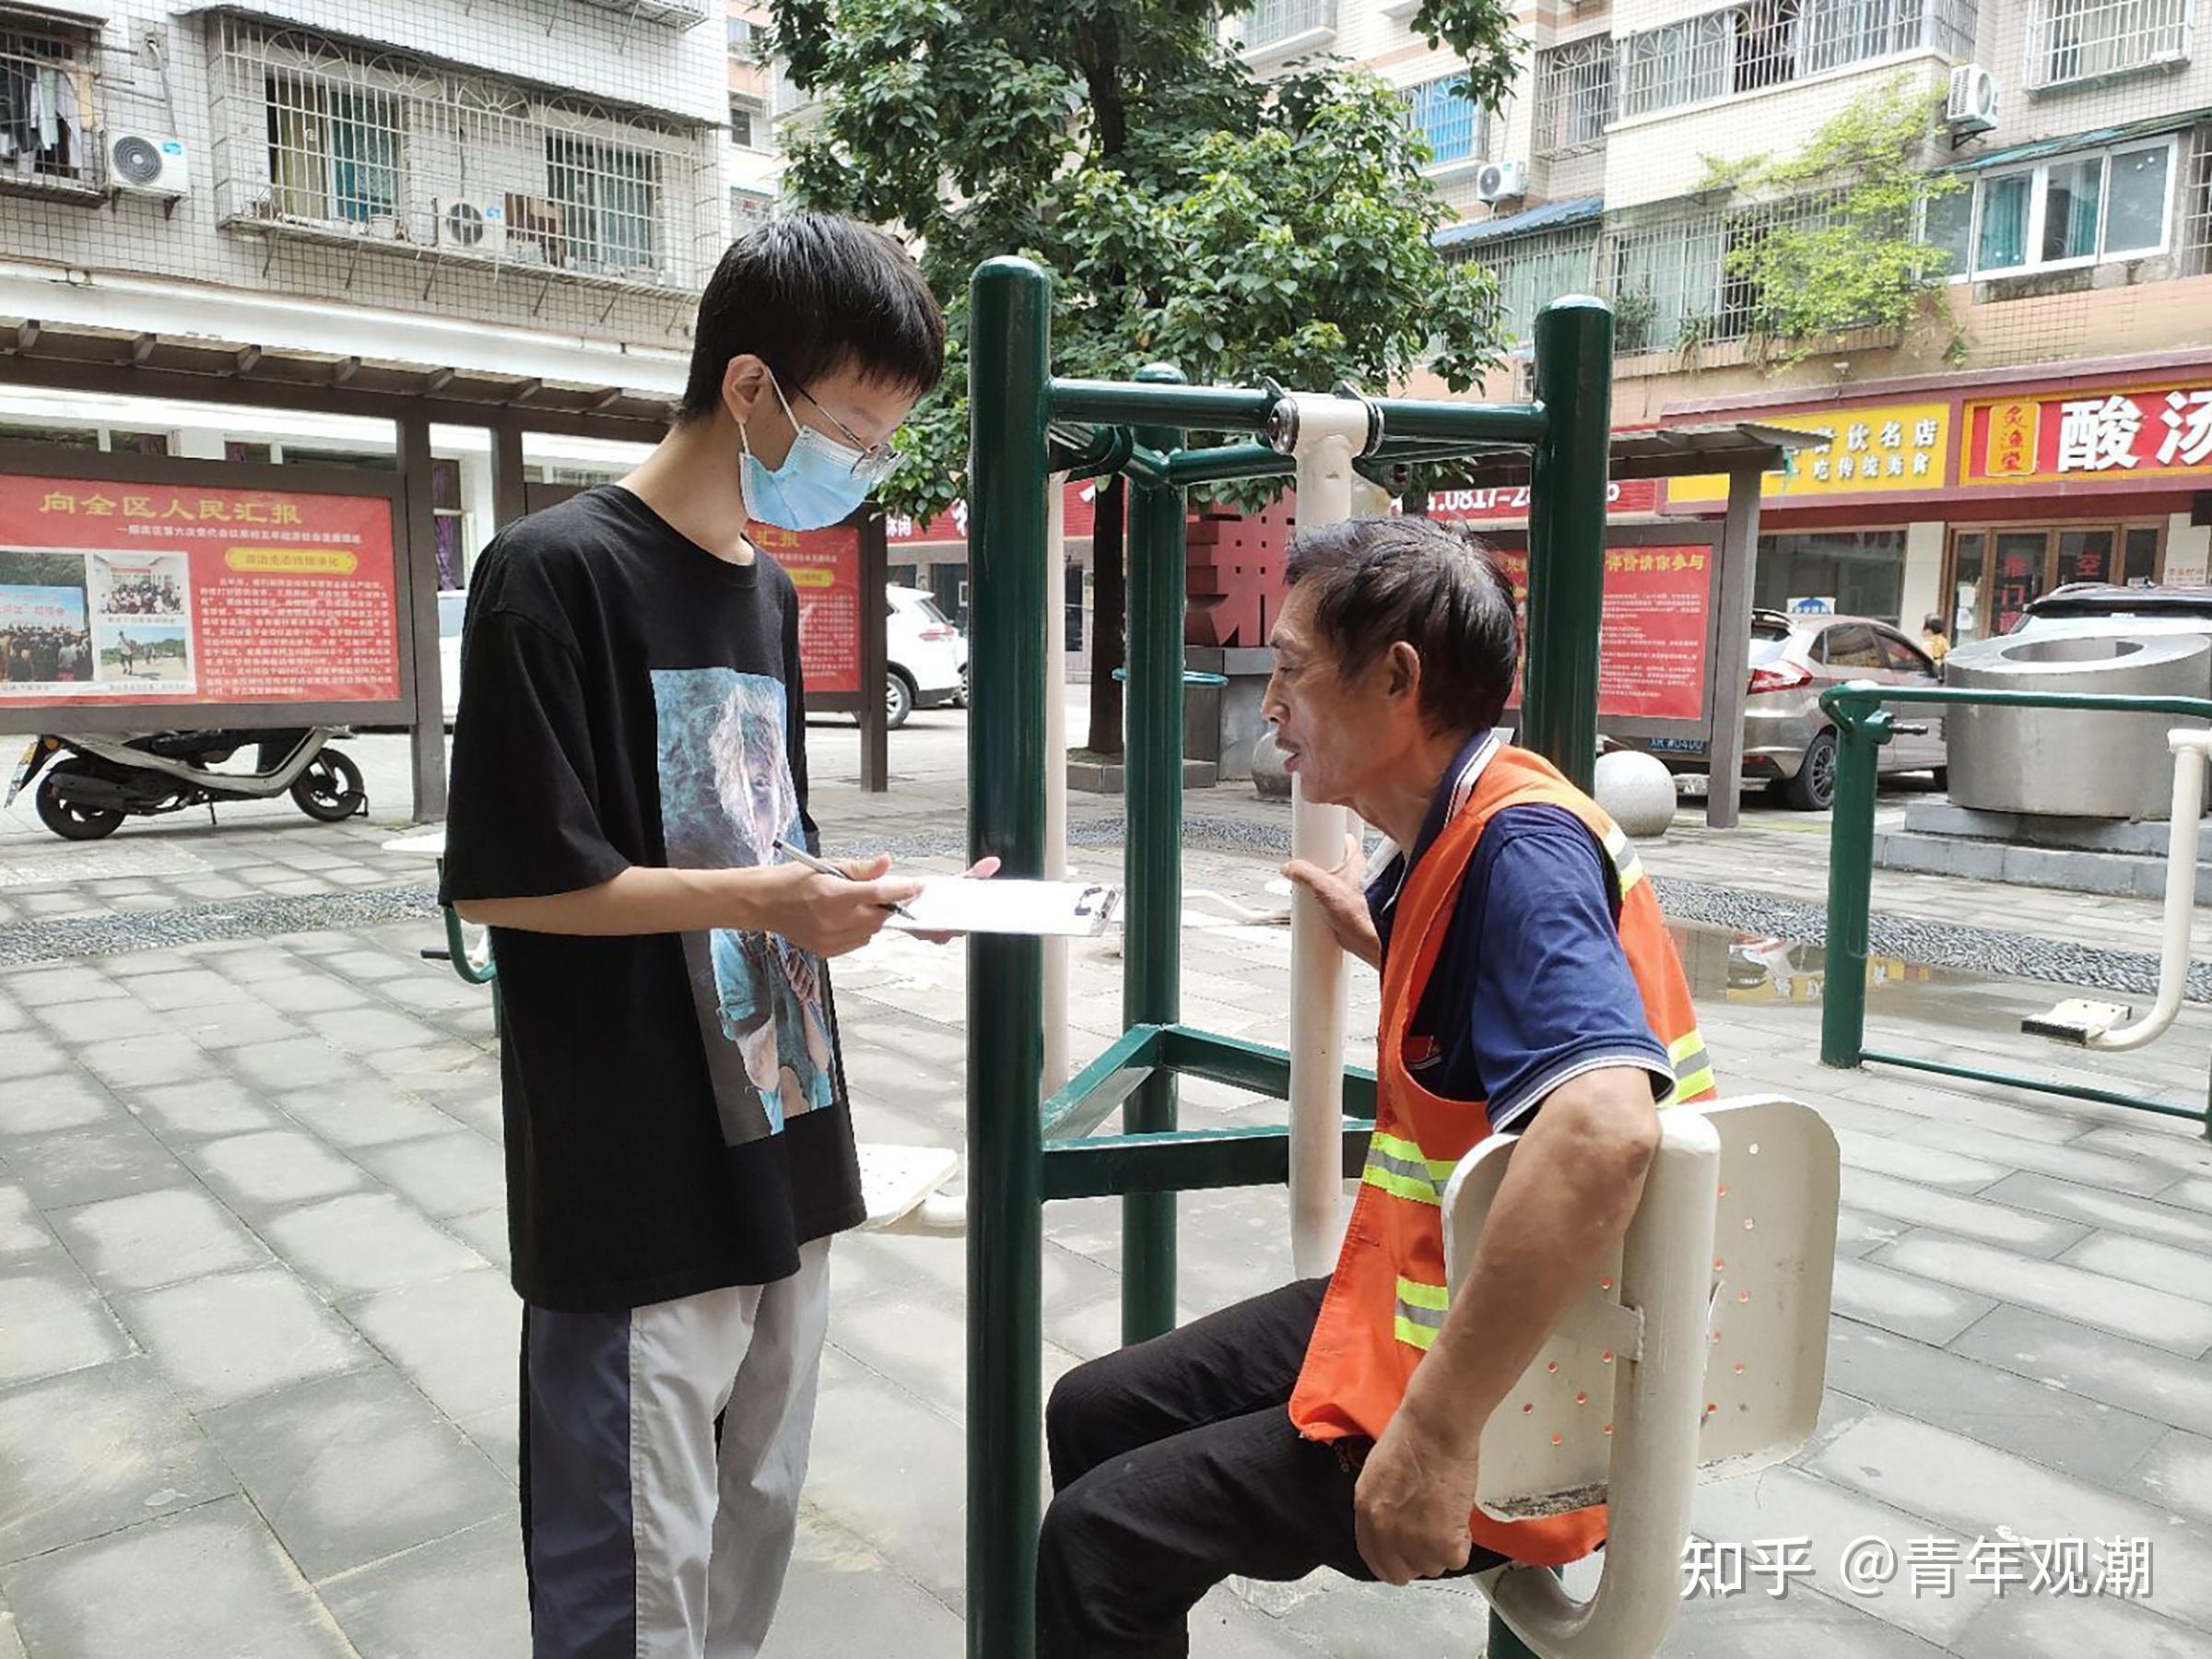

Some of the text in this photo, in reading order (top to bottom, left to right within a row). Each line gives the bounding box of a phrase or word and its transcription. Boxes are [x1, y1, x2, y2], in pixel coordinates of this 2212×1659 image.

[2058, 391, 2212, 473] 酸汤
[40, 491, 302, 524] 向全区人民汇报
